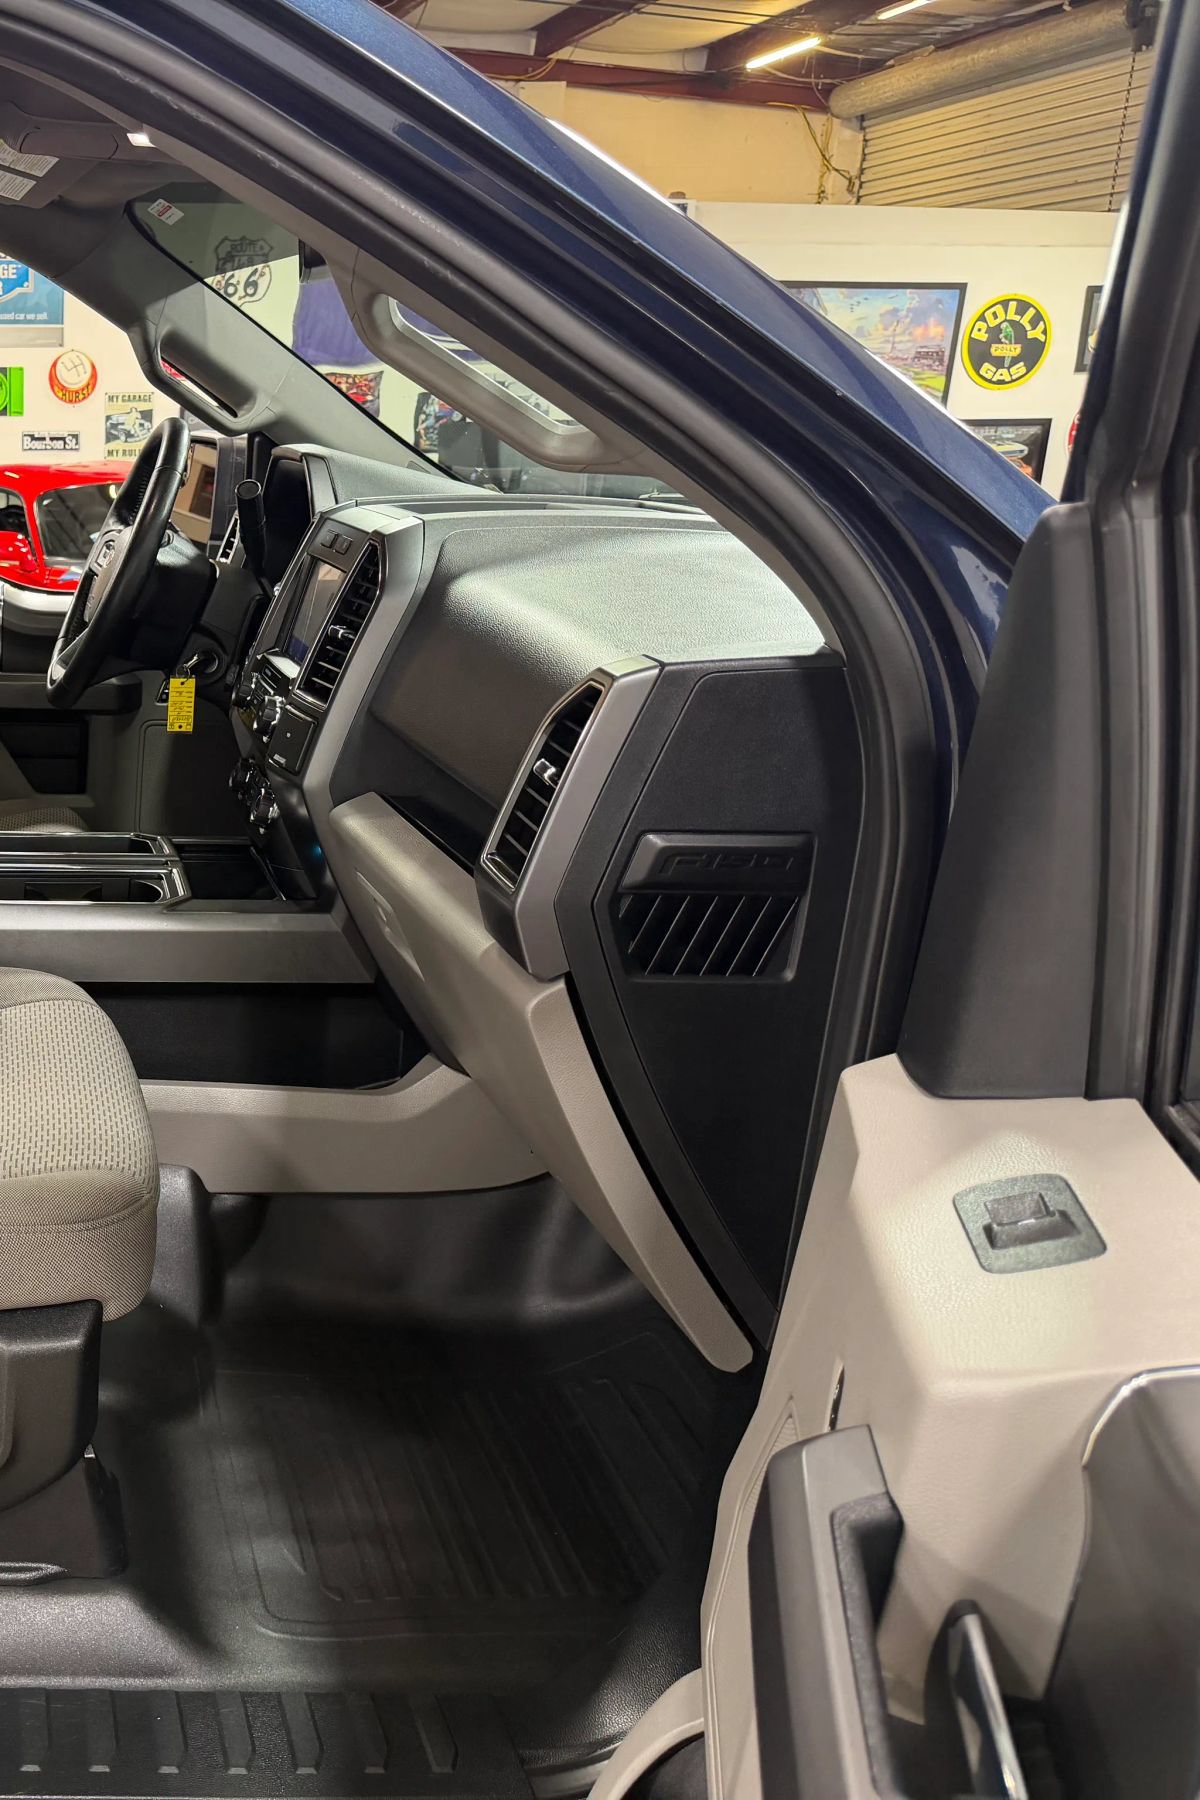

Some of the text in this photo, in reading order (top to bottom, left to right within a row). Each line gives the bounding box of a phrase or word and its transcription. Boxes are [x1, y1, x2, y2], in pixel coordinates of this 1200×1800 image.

[0, 312, 14, 320] used
[970, 301, 1046, 343] POLLY
[979, 361, 1027, 382] GAS
[61, 383, 90, 403] HURST
[107, 394, 153, 403] MY GARAGE
[23, 435, 79, 450] Bourbon St.
[107, 448, 141, 457] MY RUL
